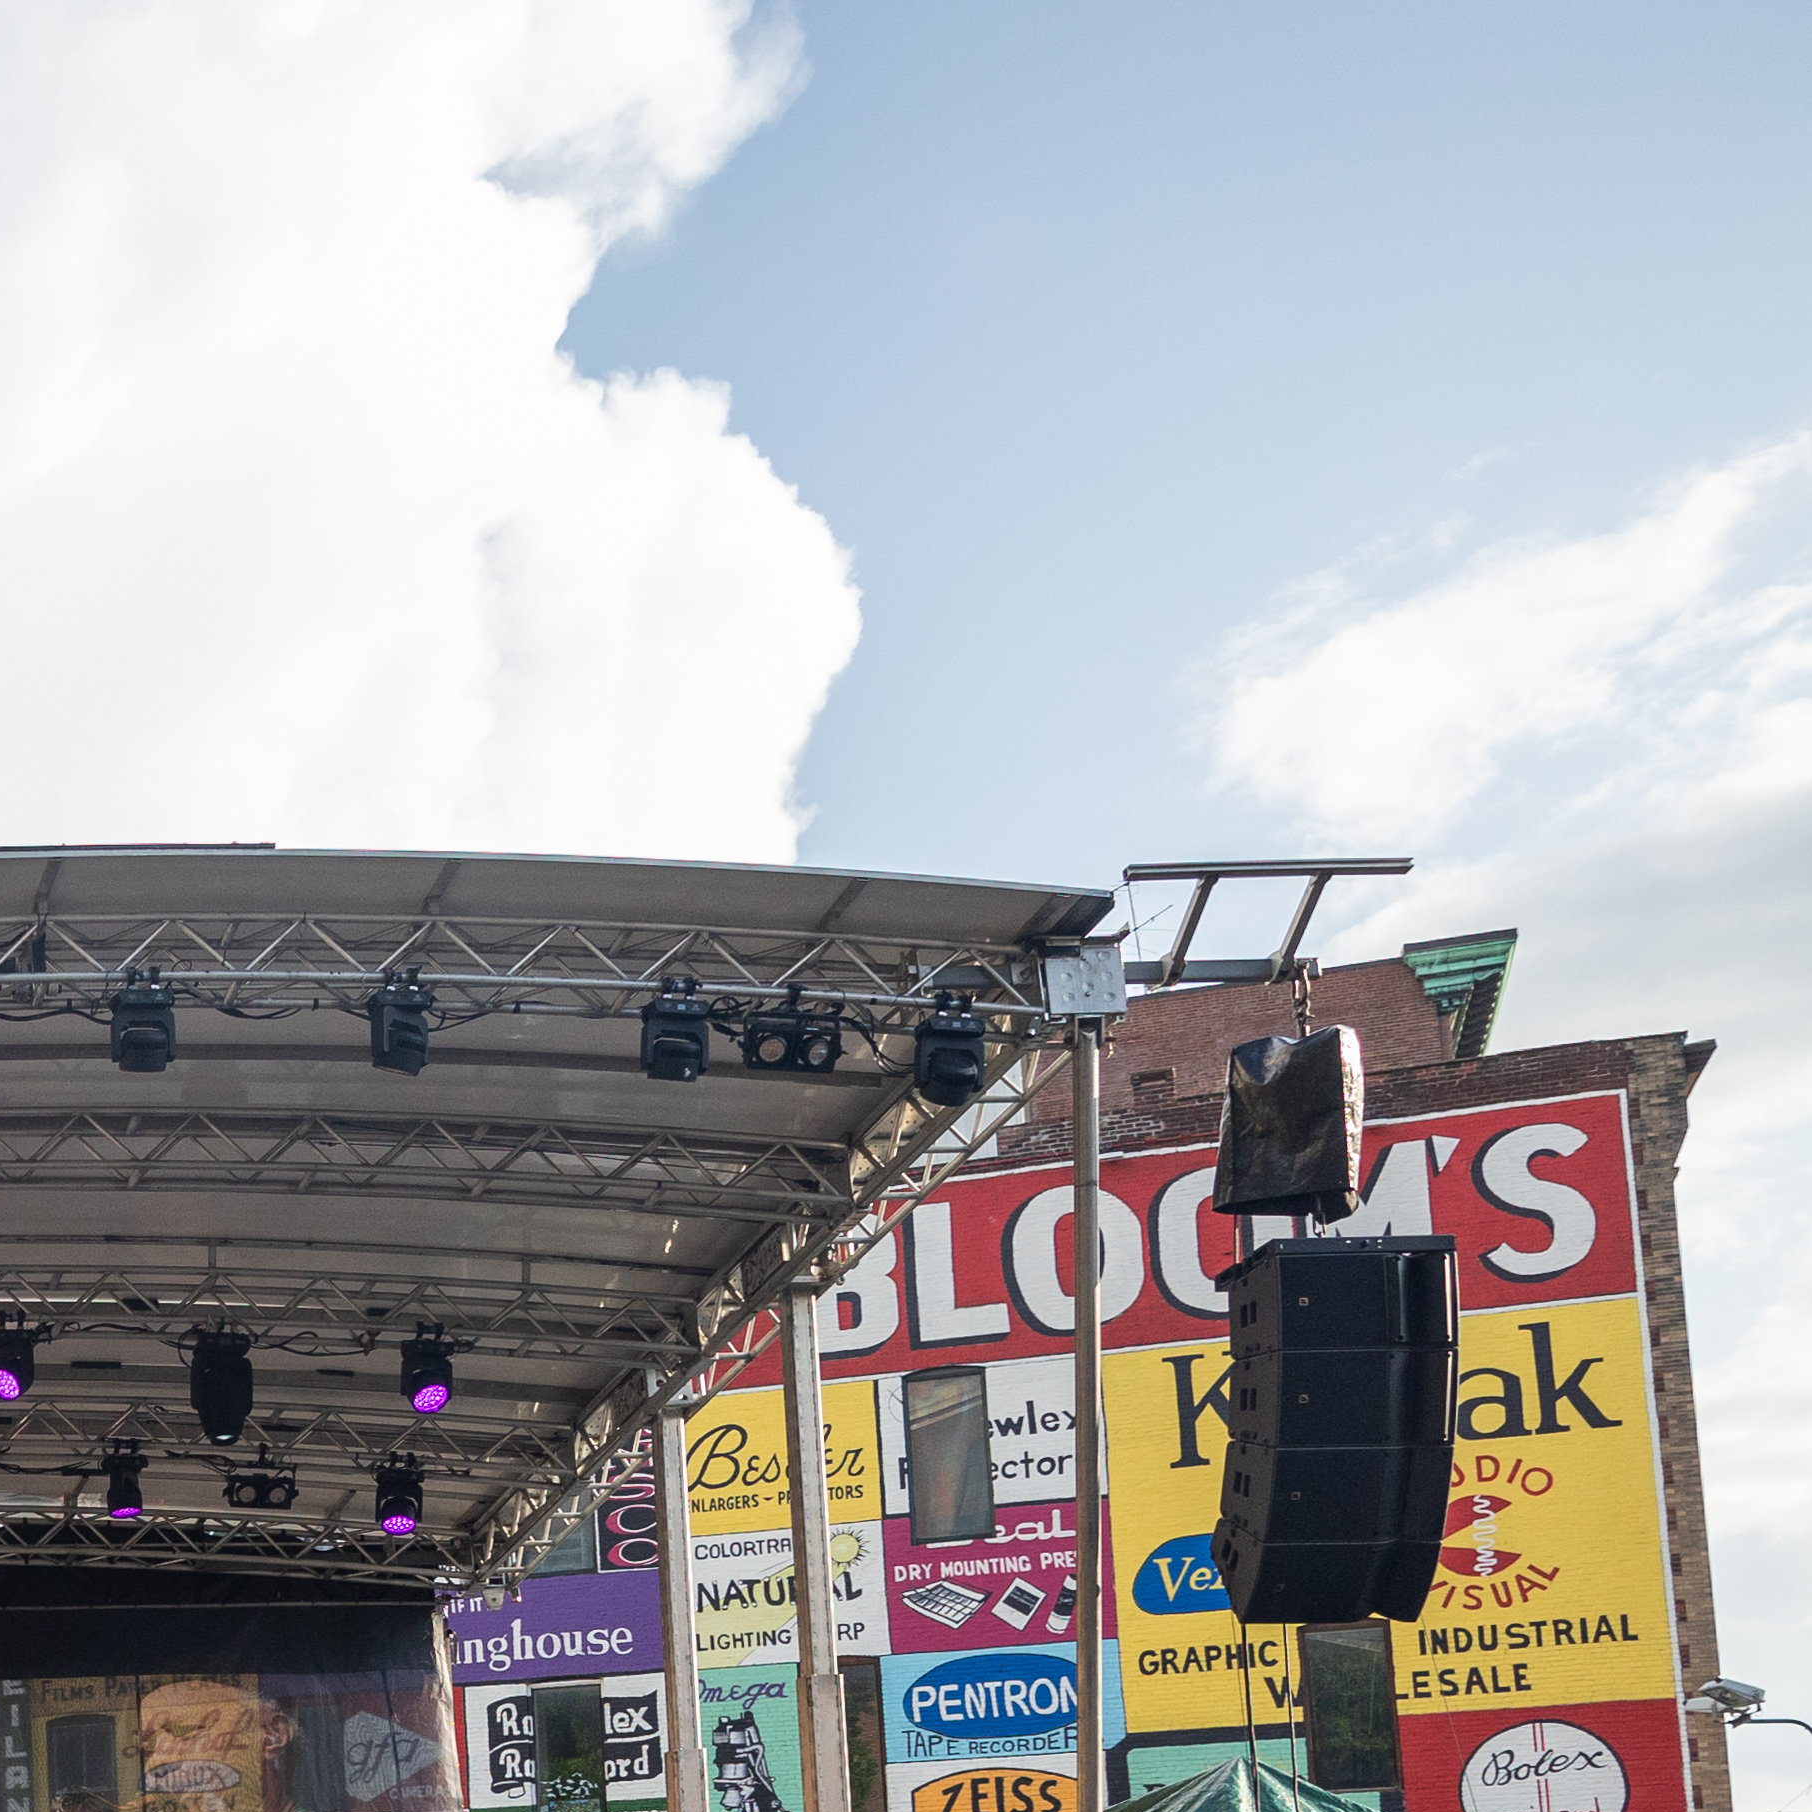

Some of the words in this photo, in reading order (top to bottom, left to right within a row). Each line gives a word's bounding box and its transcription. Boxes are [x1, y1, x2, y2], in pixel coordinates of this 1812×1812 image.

[1163, 1322, 1622, 1469] Kak
[688, 1493, 760, 1513] NLARGERS
[694, 1537, 792, 1560] COLORTRA
[894, 1563, 933, 1583] DRY
[940, 1555, 1032, 1578] MOUNTING
[1039, 1550, 1077, 1570] PRE
[452, 1617, 635, 1673] inghouse
[696, 1628, 793, 1652] LIGHTING
[836, 1621, 865, 1641] RP
[1138, 1640, 1280, 1675] GRAPHIC
[1417, 1614, 1639, 1656] INDUSTRIAL
[1266, 1662, 1533, 1709] WLESALE
[902, 1729, 961, 1758] TAPE
[968, 1725, 1078, 1756] RECORDER
[1480, 1748, 1609, 1787] Bolex
